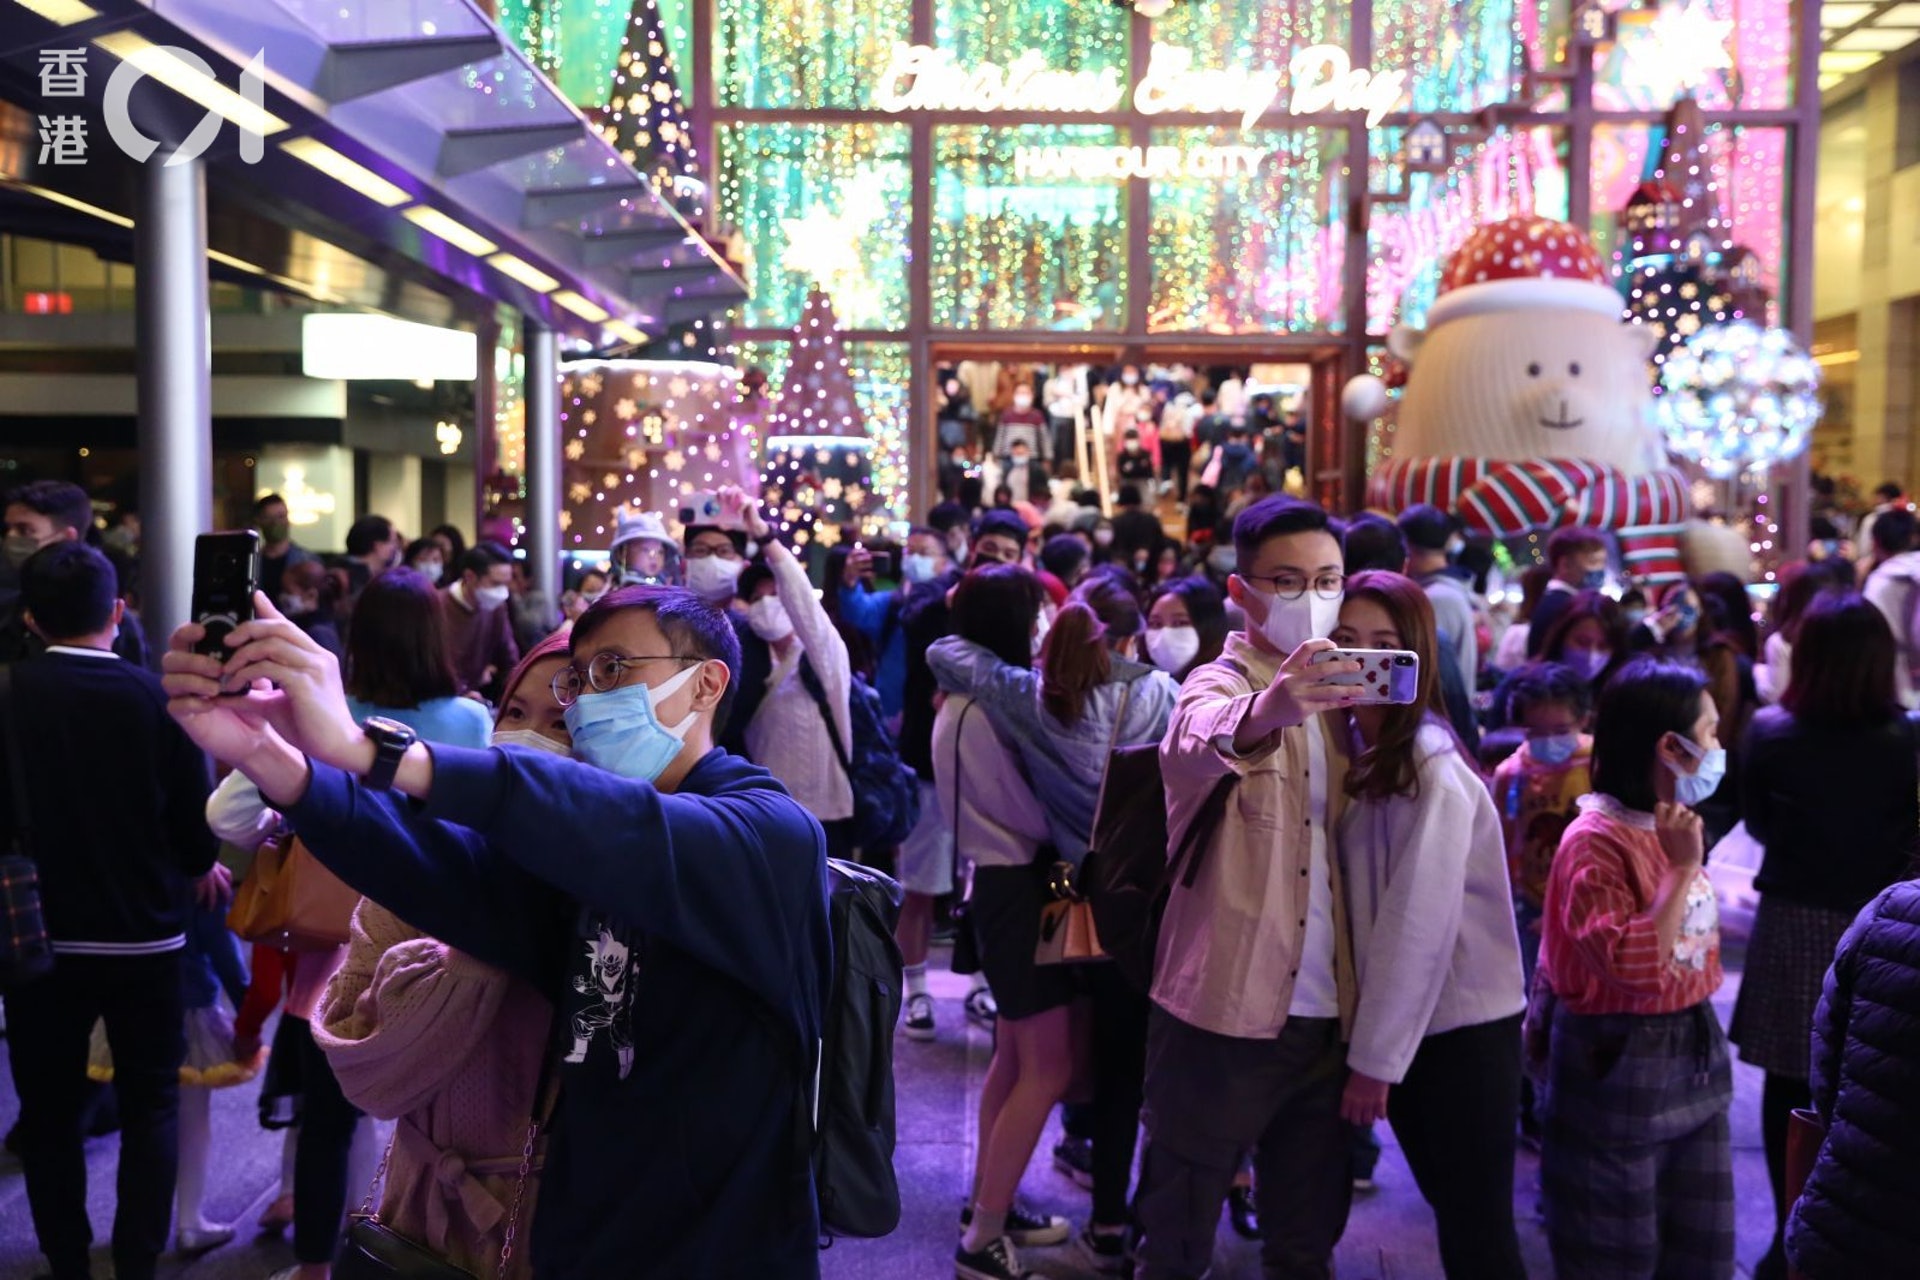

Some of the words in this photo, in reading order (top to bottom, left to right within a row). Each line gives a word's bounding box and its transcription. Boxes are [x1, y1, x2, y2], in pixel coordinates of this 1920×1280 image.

[1289, 44, 1406, 129] Day
[1014, 145, 1183, 179] HARBOUR
[1187, 145, 1269, 178] CITY
